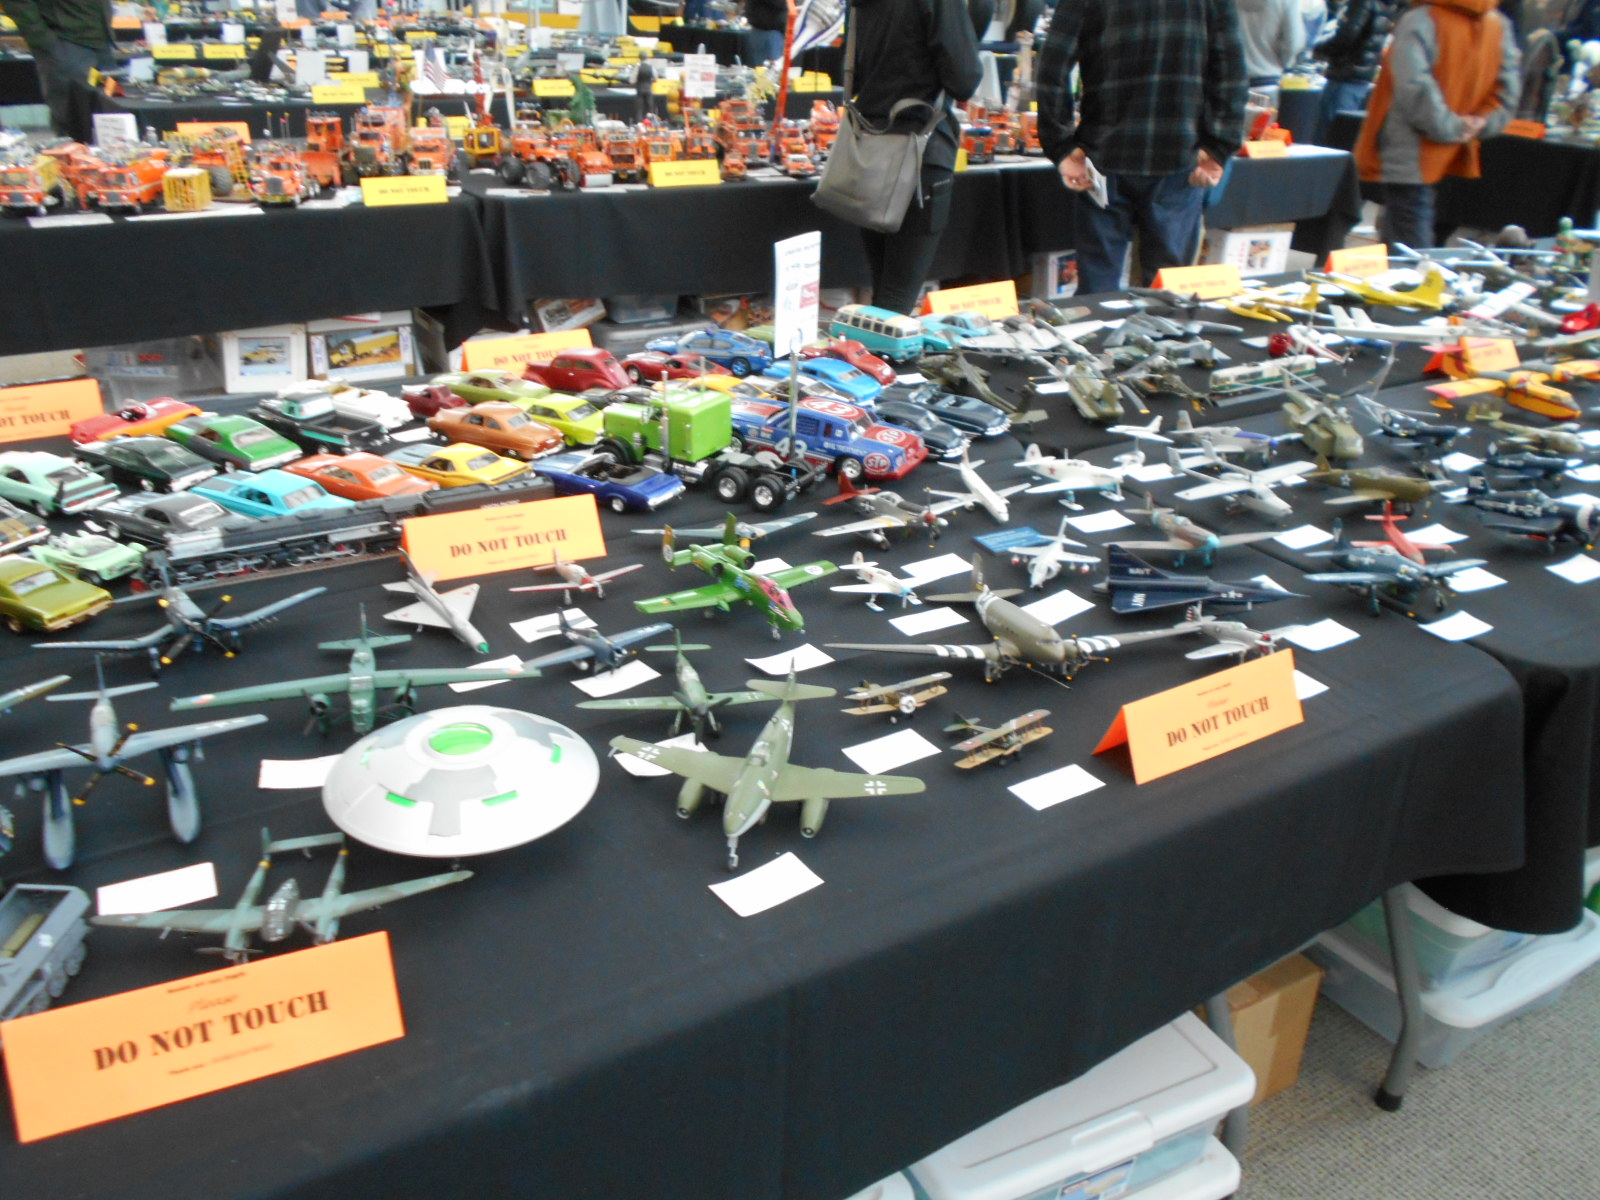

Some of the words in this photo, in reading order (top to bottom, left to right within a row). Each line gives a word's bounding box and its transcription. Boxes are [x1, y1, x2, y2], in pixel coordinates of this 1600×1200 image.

[493, 356, 508, 366] DO
[511, 352, 532, 364] NOT
[810, 401, 847, 416] 43
[20, 409, 71, 425] TOUCH
[867, 455, 888, 470] STP
[449, 543, 472, 558] DO
[477, 537, 509, 554] NOT
[514, 528, 568, 548] TOUCH
[1128, 567, 1152, 576] NAVY
[1166, 727, 1187, 748] DO
[1191, 714, 1220, 738] NOT
[1222, 695, 1270, 726] TOUCH
[92, 1040, 139, 1071] DO
[149, 1019, 214, 1057] NOT
[223, 989, 330, 1036] TOUCH
